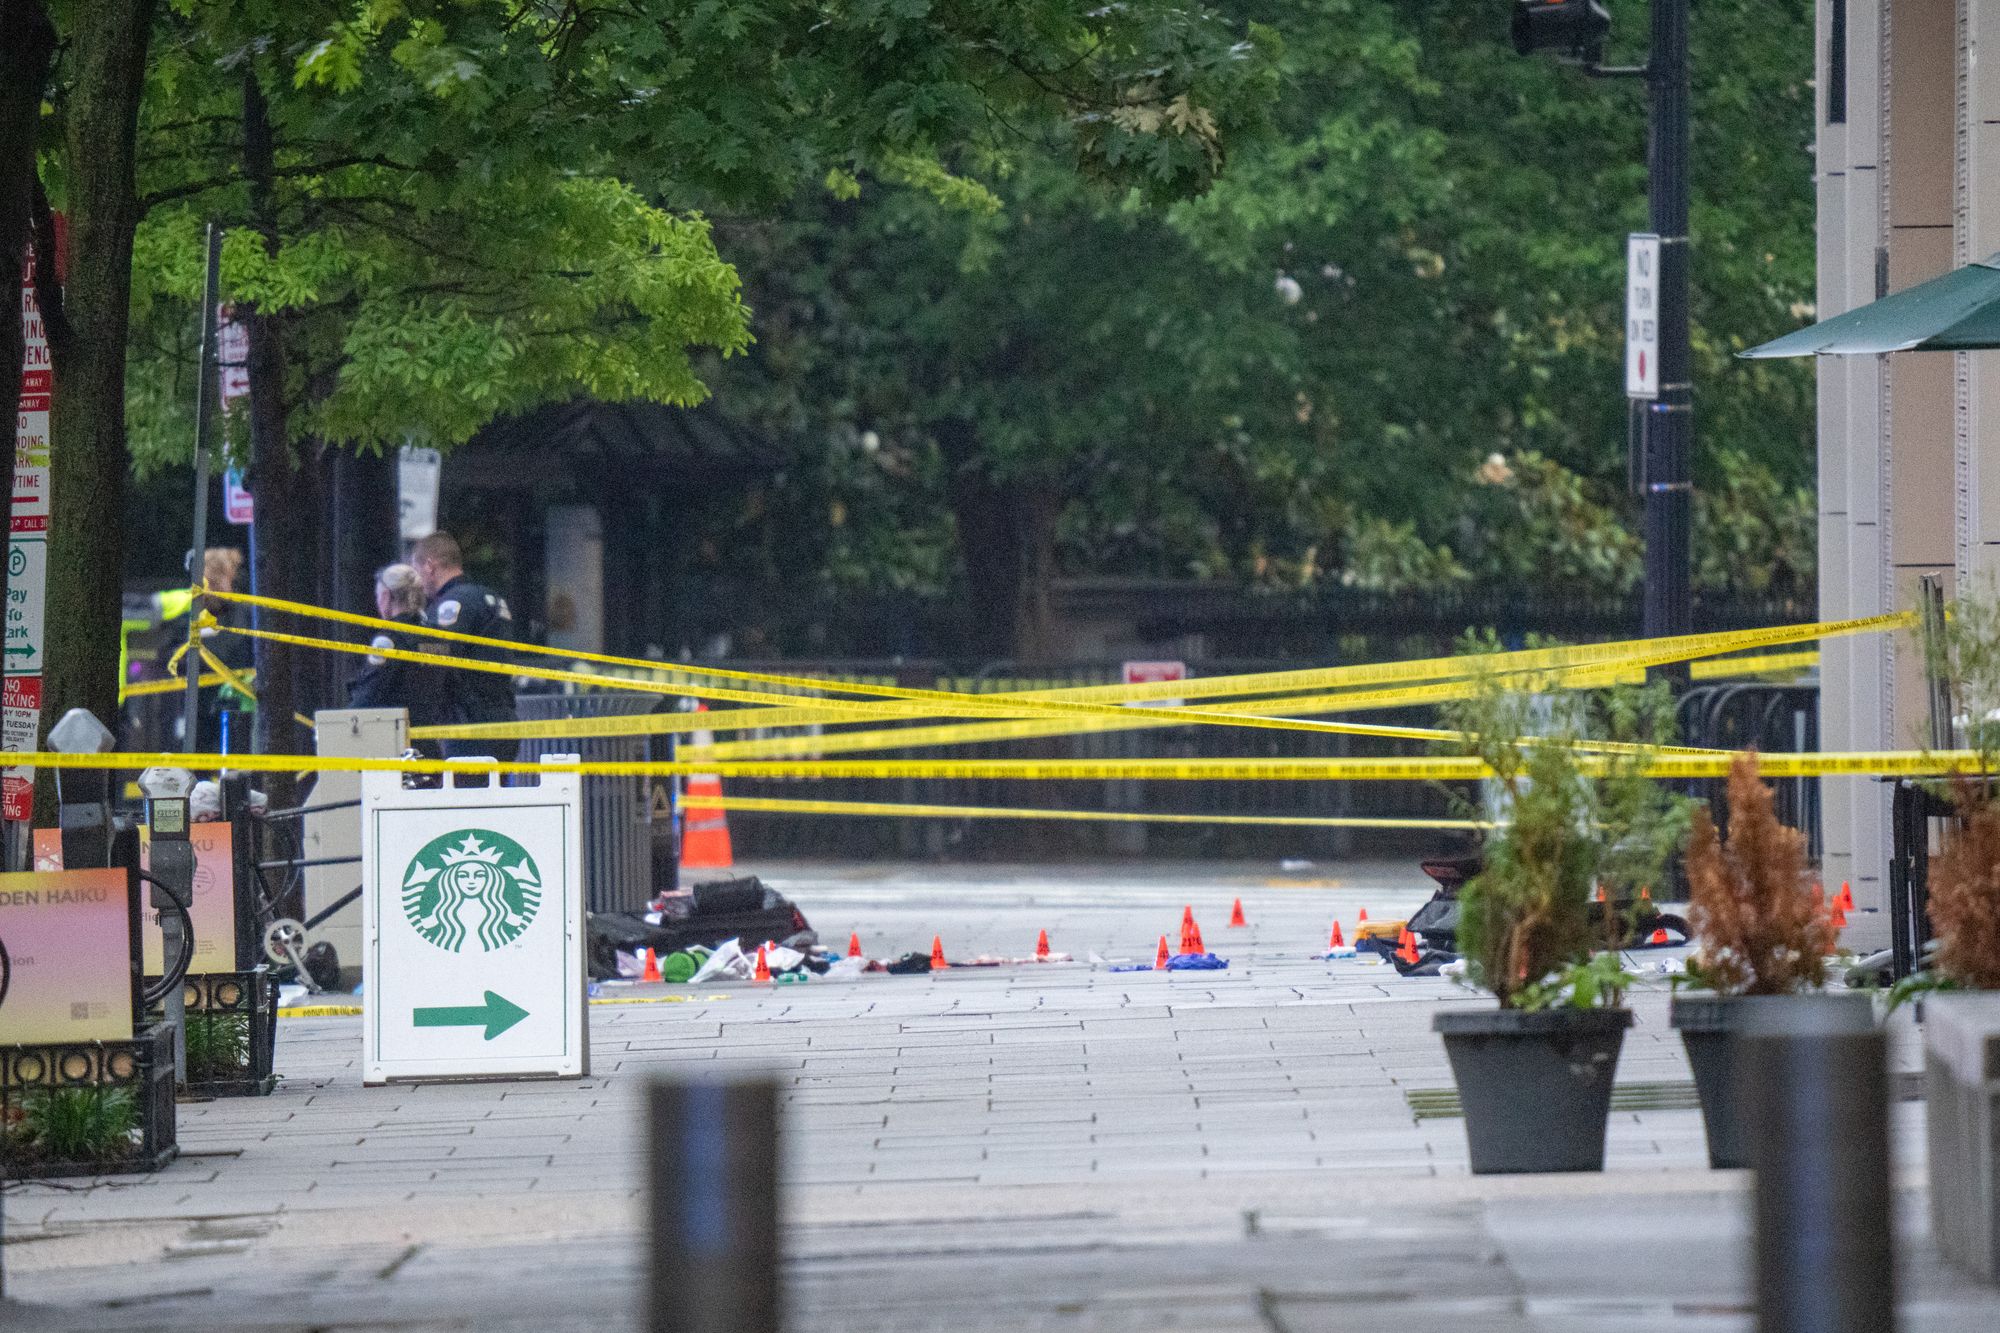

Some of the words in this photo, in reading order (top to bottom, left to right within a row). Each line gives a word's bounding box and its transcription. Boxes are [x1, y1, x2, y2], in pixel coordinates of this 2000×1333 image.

[25, 378, 43, 387] AWAY
[25, 519, 38, 529] CALL
[6, 625, 28, 638] ark
[4, 679, 20, 692] NO
[6, 721, 37, 730] TUESDAY
[47, 888, 108, 904] HAIKU
